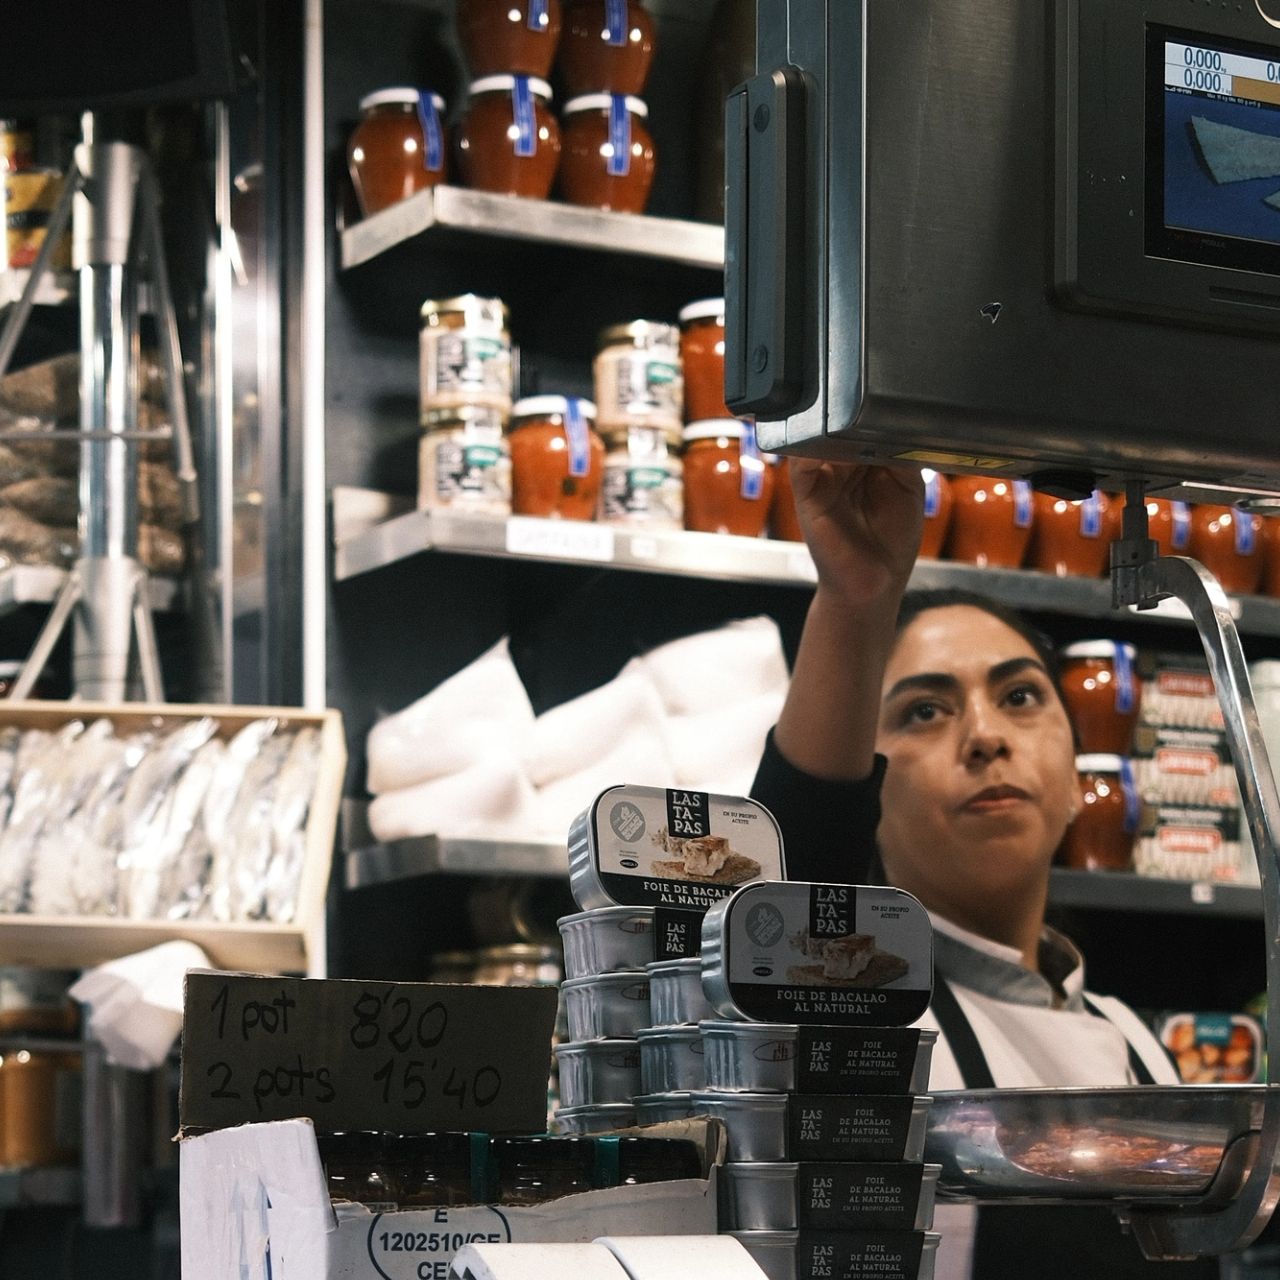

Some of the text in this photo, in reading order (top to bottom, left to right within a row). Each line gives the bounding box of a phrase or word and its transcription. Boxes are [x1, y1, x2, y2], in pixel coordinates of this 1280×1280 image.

[1184, 47, 1221, 71] 0,000
[1184, 68, 1221, 92] 0,000
[672, 791, 701, 807] LAS
[672, 805, 702, 820] TA-
[674, 819, 703, 834] PAS
[643, 882, 670, 893] FOIE
[674, 884, 689, 895] DE
[660, 893, 719, 907] AL NATUR
[817, 888, 848, 903] LAS
[816, 903, 847, 918] TA-
[667, 922, 686, 933] LAS
[816, 919, 848, 933] PAS
[666, 942, 685, 953] PAS
[777, 990, 887, 1004] FOIE DE BACALAO
[210, 985, 229, 1040] 1
[242, 990, 297, 1041] pot
[794, 1002, 871, 1014] AL NATURAL
[812, 1041, 831, 1051] LAS
[863, 1041, 881, 1049] FOIE
[861, 1051, 898, 1059] BACALAO
[809, 1062, 829, 1072] PAS
[859, 1060, 896, 1068] NATURAL
[206, 1062, 241, 1100] 2
[253, 1055, 336, 1113] pots
[802, 1110, 822, 1119] LAS
[855, 1108, 874, 1116] FOIE
[853, 1118, 891, 1126] BACALAO
[800, 1130, 820, 1140] PAS
[813, 1178, 833, 1188] LAS
[865, 1176, 885, 1184] FOIE
[863, 1186, 902, 1194] BACALAO
[811, 1198, 831, 1209] PAS
[861, 1196, 900, 1204] NATURAL
[434, 1207, 448, 1223] E
[813, 1246, 834, 1256] LAS
[866, 1244, 885, 1252] FOIE
[864, 1254, 902, 1262] BACALAO
[417, 1261, 451, 1280] CE
[811, 1266, 832, 1276] PAS
